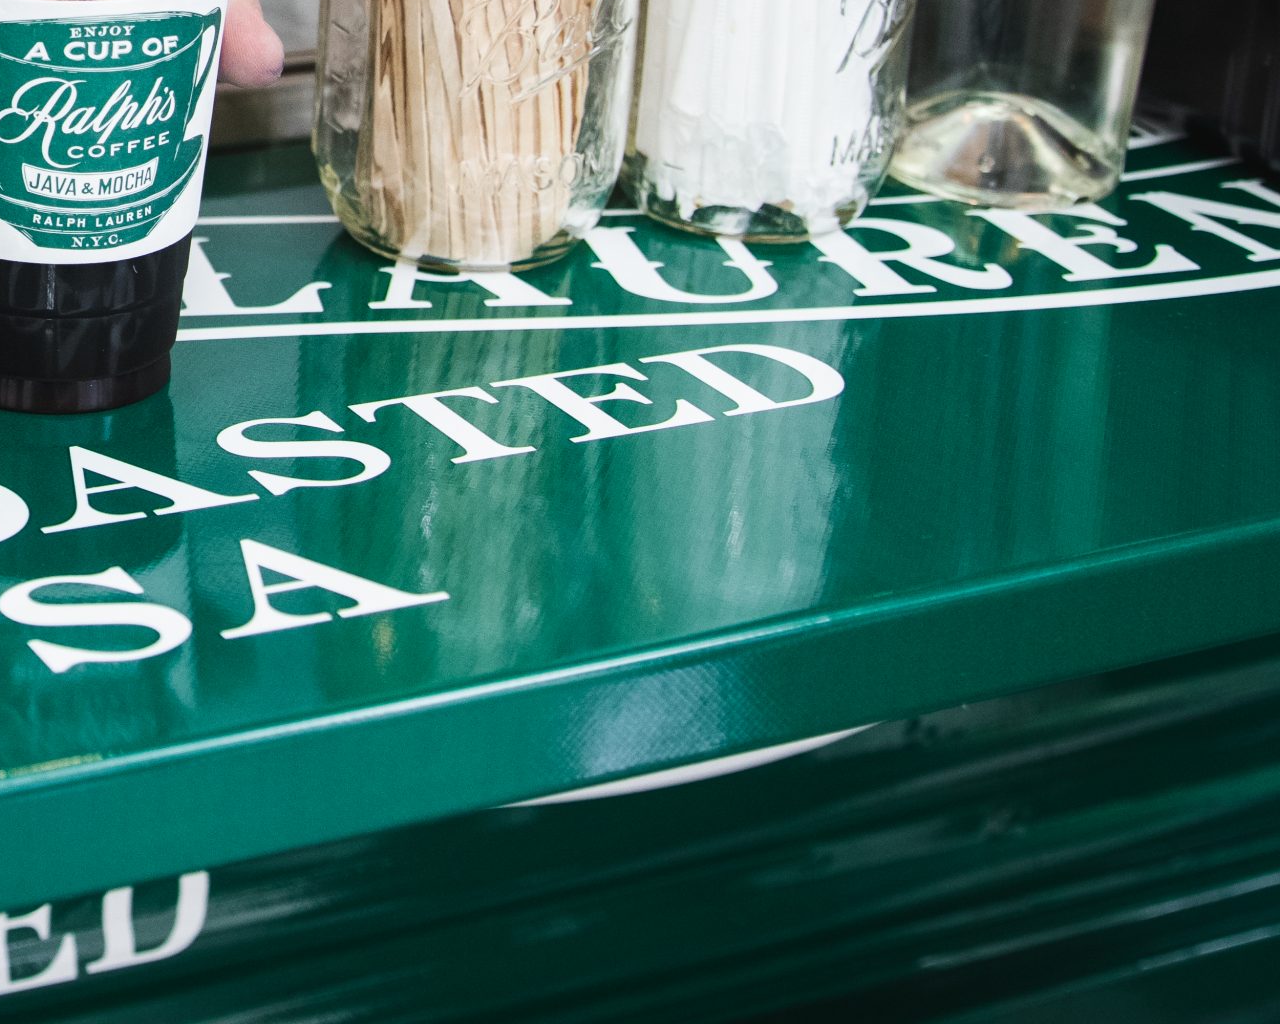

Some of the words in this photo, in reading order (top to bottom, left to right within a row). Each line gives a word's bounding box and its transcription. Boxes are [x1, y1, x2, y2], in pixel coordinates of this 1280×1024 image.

[70, 24, 135, 39] ENJOY
[23, 41, 51, 62] A
[63, 39, 133, 62] CUP
[142, 35, 180, 57] OF
[67, 130, 170, 159] COFFEE
[29, 173, 76, 196] JAVA
[81, 182, 94, 195] &
[97, 166, 153, 196] MOCHA
[32, 213, 86, 228] RALPH
[95, 205, 152, 228] LAUREN
[71, 233, 123, 248] N.Y.C.
